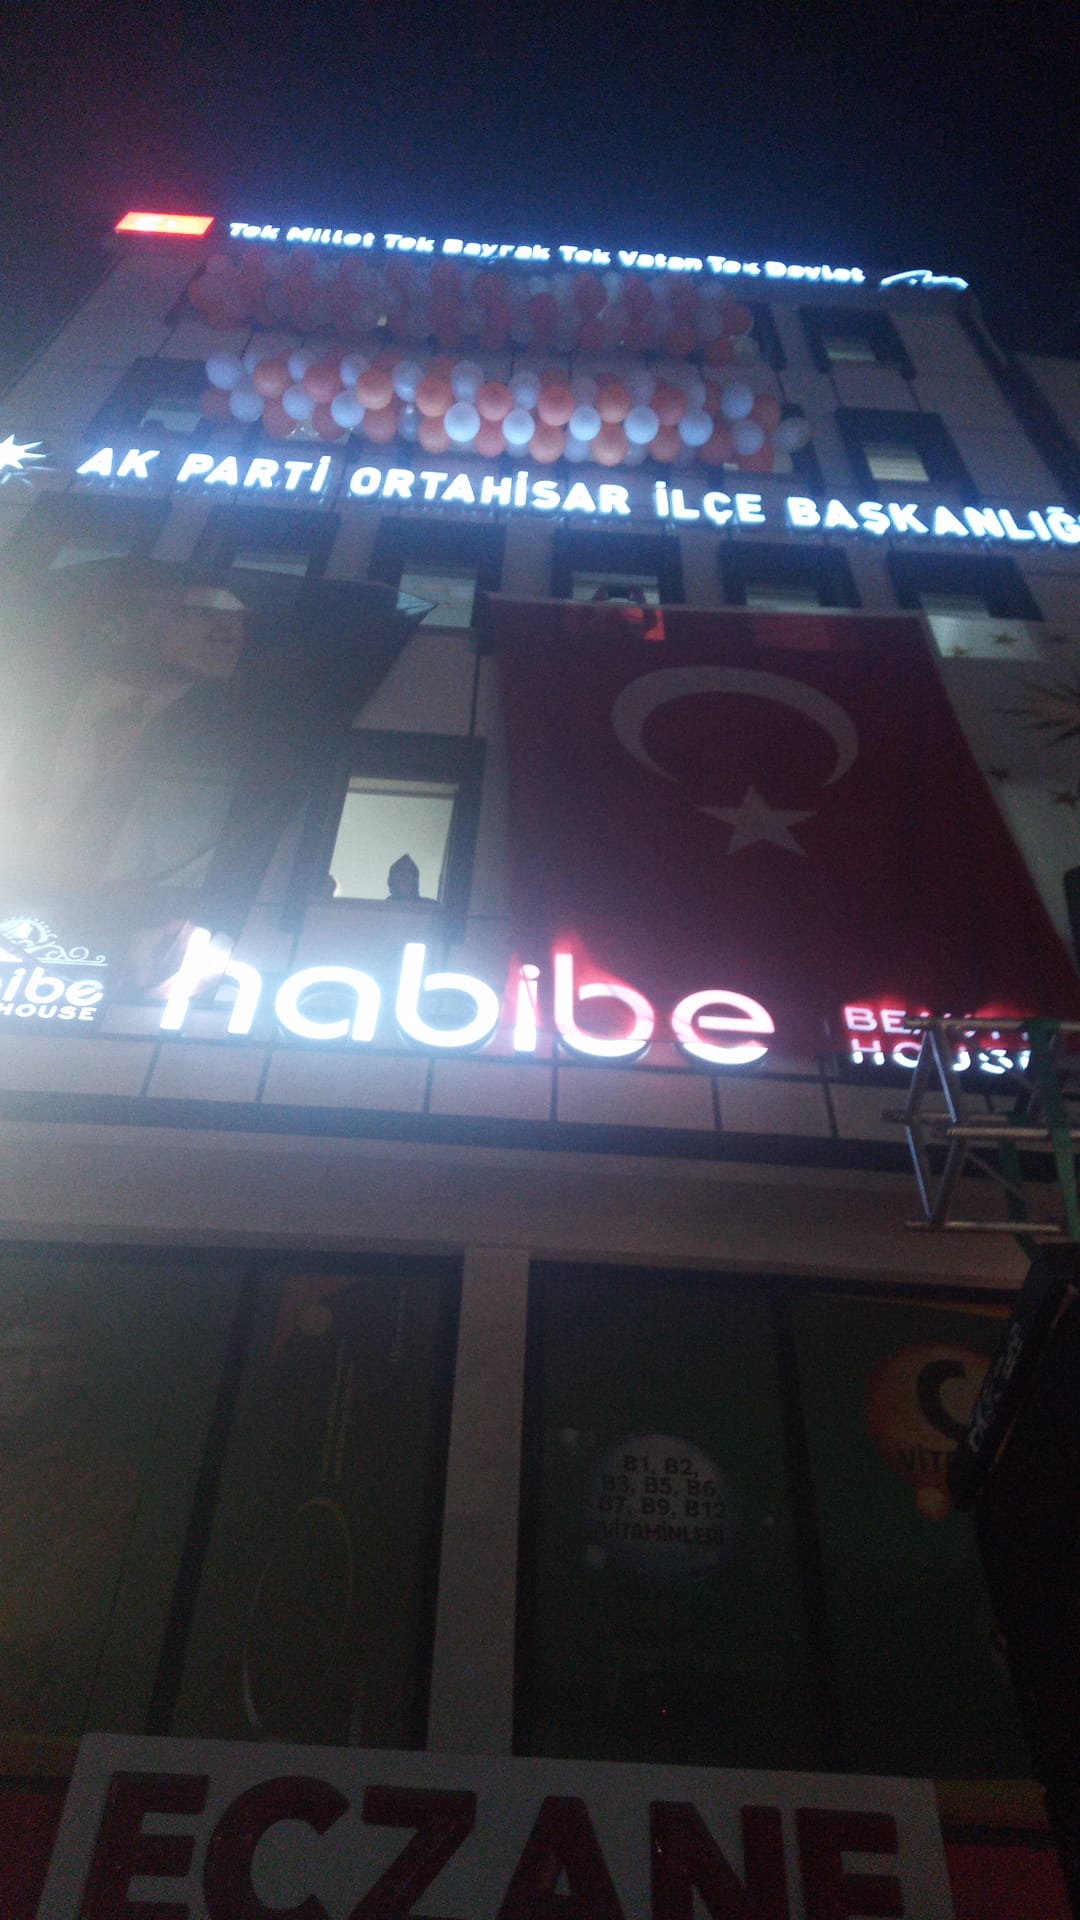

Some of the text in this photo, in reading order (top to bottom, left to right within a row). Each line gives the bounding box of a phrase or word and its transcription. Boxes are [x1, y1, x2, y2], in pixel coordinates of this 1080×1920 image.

[76, 446, 161, 480] AK
[176, 453, 334, 494] PARTİ
[346, 465, 632, 517] ORTAHİSAR
[785, 496, 1080, 545] BAŞKANLIĞ
[160, 926, 777, 1066] habibe
[77, 1770, 905, 1920] ECZANE
